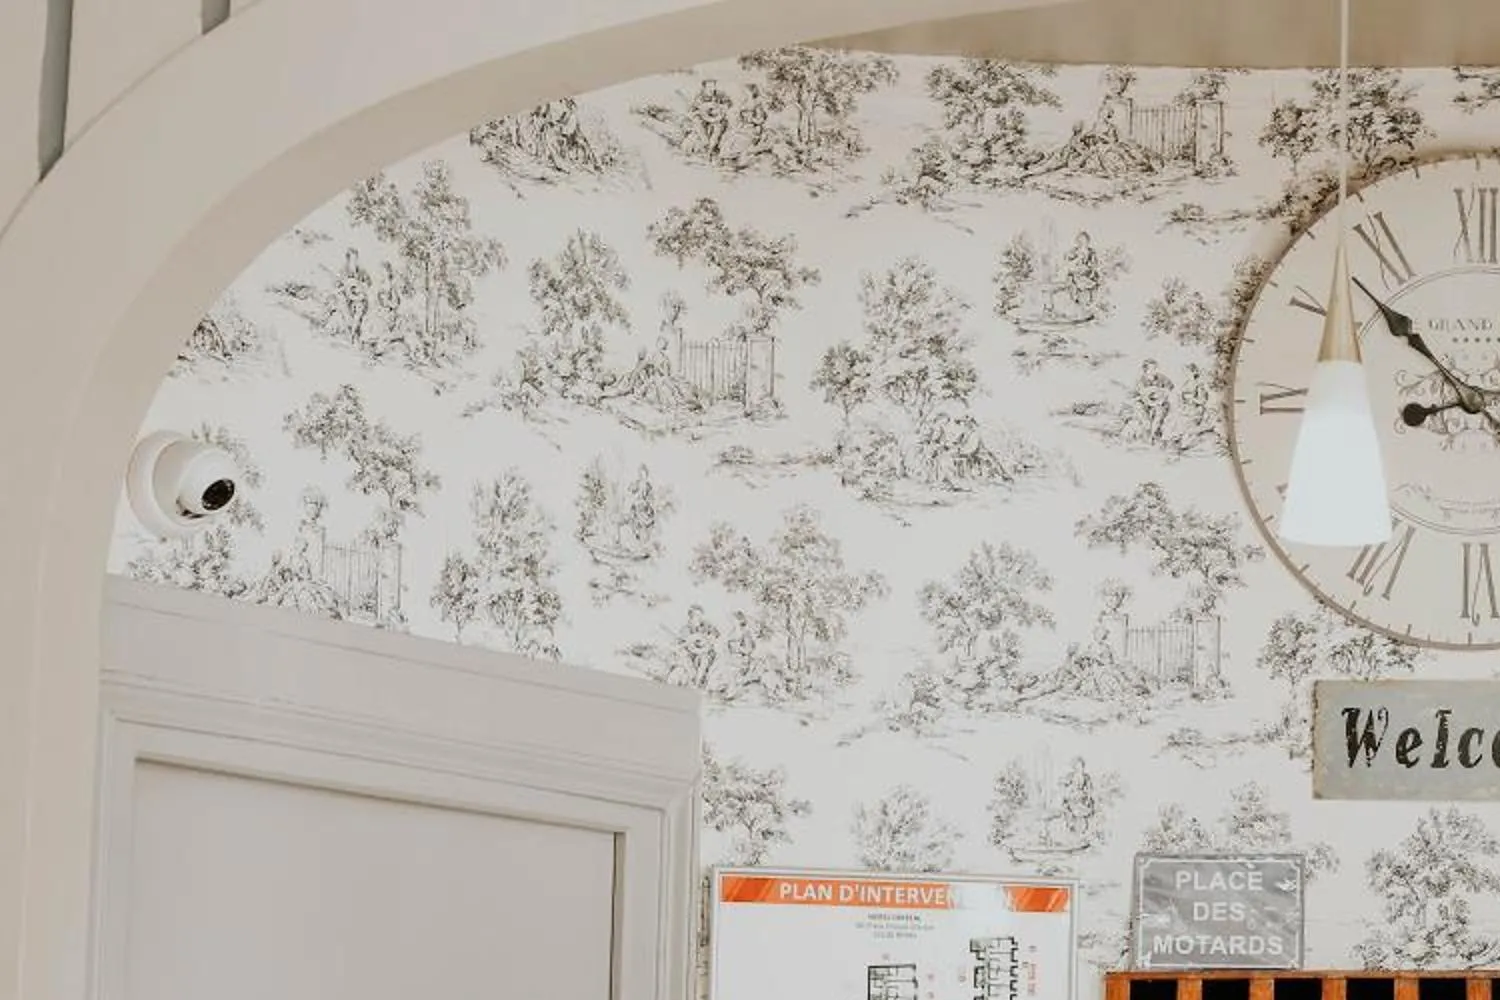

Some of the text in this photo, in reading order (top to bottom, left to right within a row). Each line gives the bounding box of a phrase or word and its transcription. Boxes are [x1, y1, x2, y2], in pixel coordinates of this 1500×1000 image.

[1454, 184, 1498, 263] XII
[1428, 317, 1493, 331] GRAND
[1175, 870, 1264, 891] PLACE
[779, 882, 833, 900] PLAN
[1192, 901, 1246, 921] DES
[1153, 935, 1284, 955] MOTARDS
